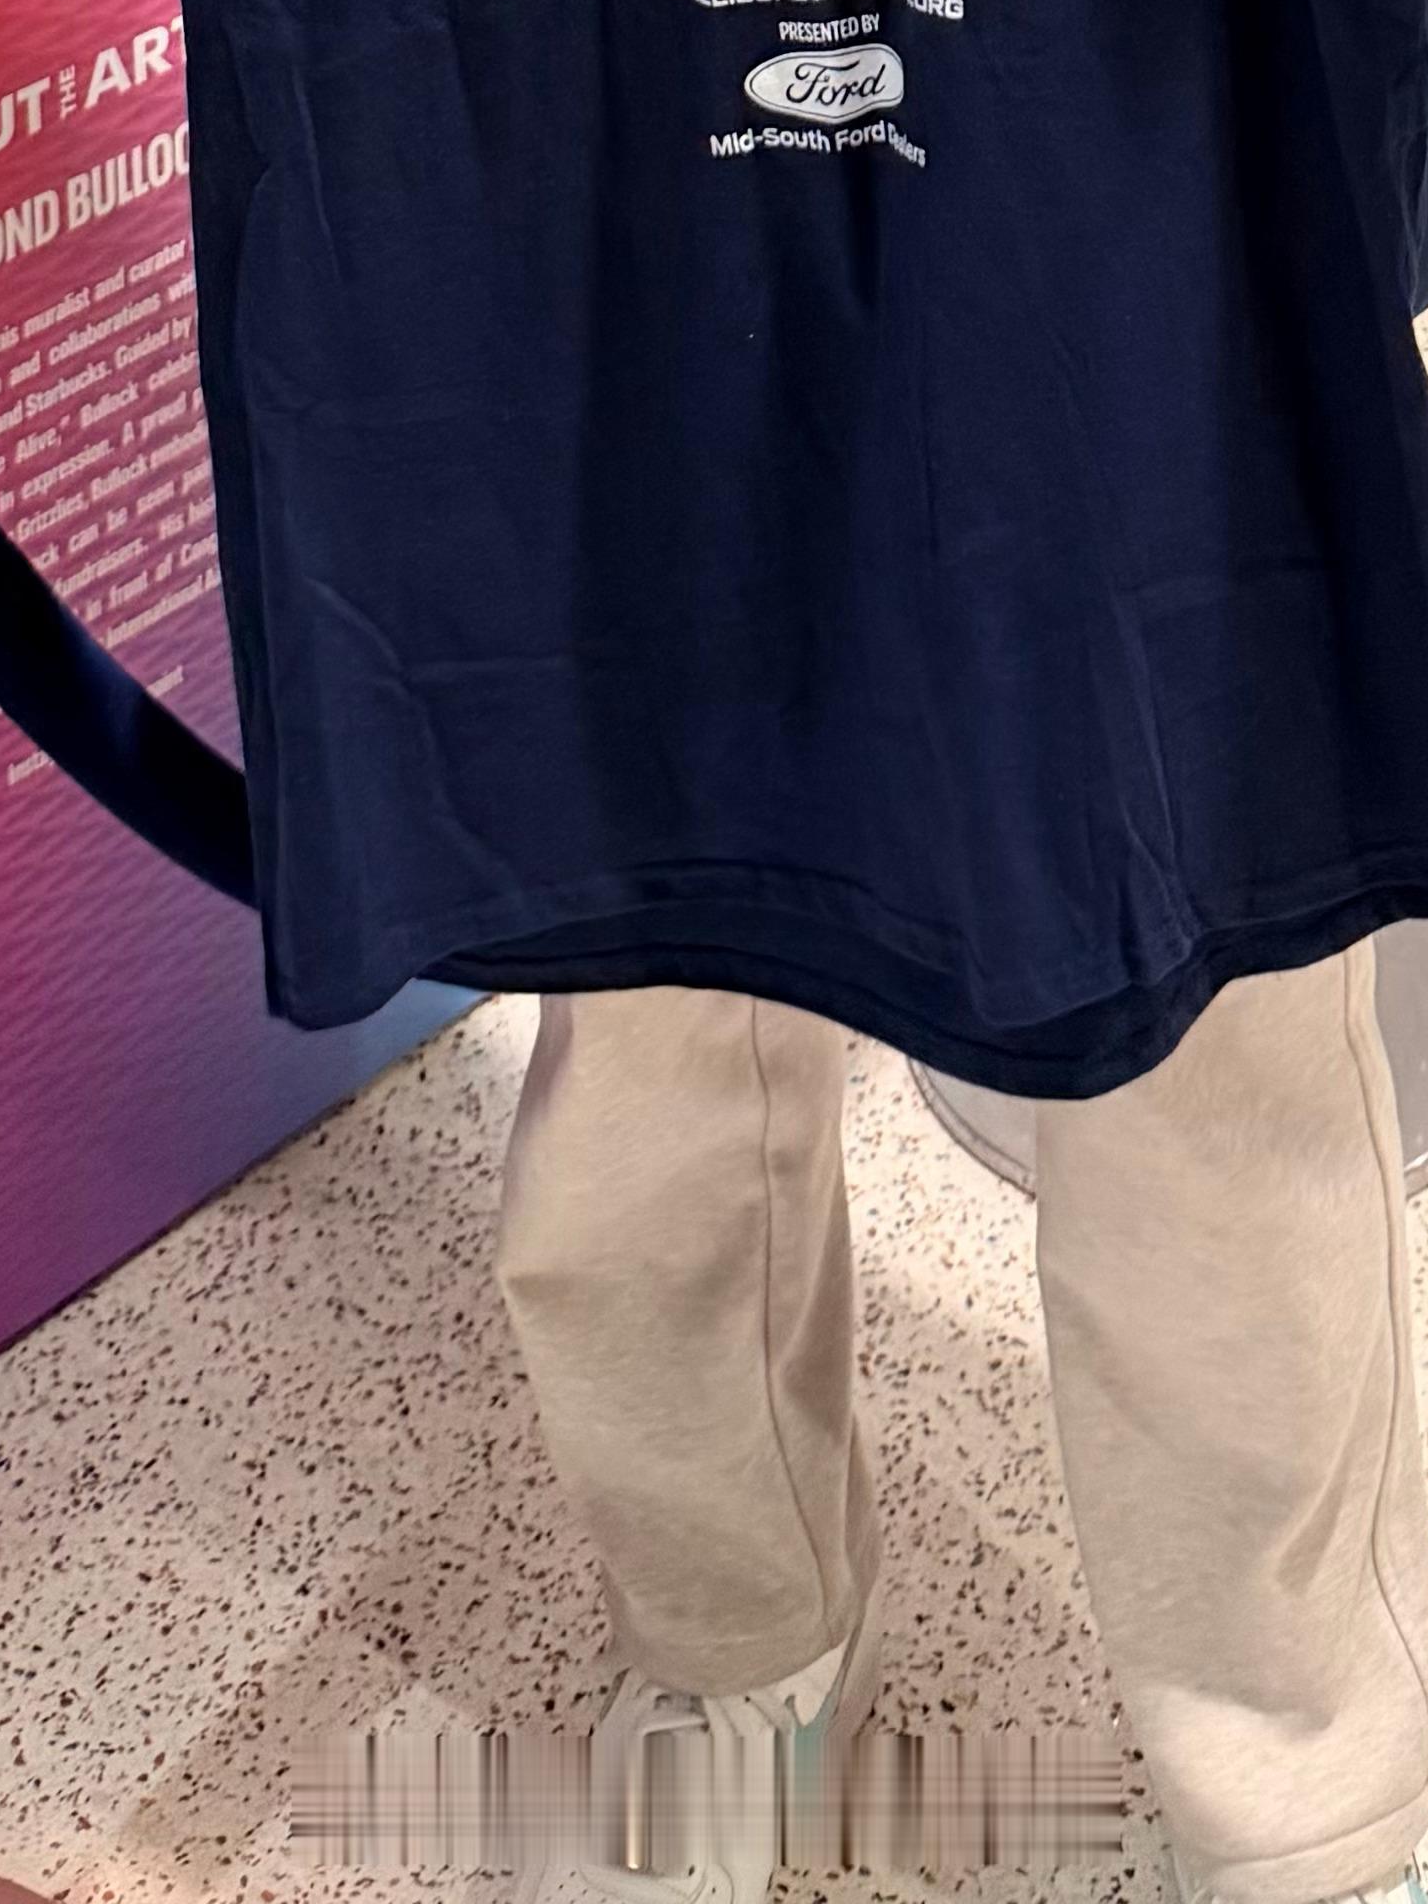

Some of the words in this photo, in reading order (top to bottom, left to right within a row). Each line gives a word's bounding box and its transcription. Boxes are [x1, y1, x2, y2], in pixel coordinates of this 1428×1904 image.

[779, 16, 859, 43] PRESENTED
[862, 13, 880, 34] BY
[59, 64, 77, 121] THE
[786, 59, 887, 107] Ford
[67, 119, 190, 230] BULLOC
[710, 128, 831, 159] Mid-South
[835, 120, 886, 152] Ford
[23, 286, 90, 338] muralist
[94, 265, 125, 302] and
[129, 239, 186, 283] curator
[9, 350, 41, 386] and
[49, 292, 162, 365] collaborations
[25, 361, 112, 419] Starbucks.
[115, 322, 170, 370] Guided
[172, 315, 193, 341] by
[80, 380, 138, 430] Bullock
[18, 492, 90, 542] Grizzlies,
[91, 453, 149, 502] Bullock
[21, 440, 115, 501] expression.
[123, 420, 135, 448] A
